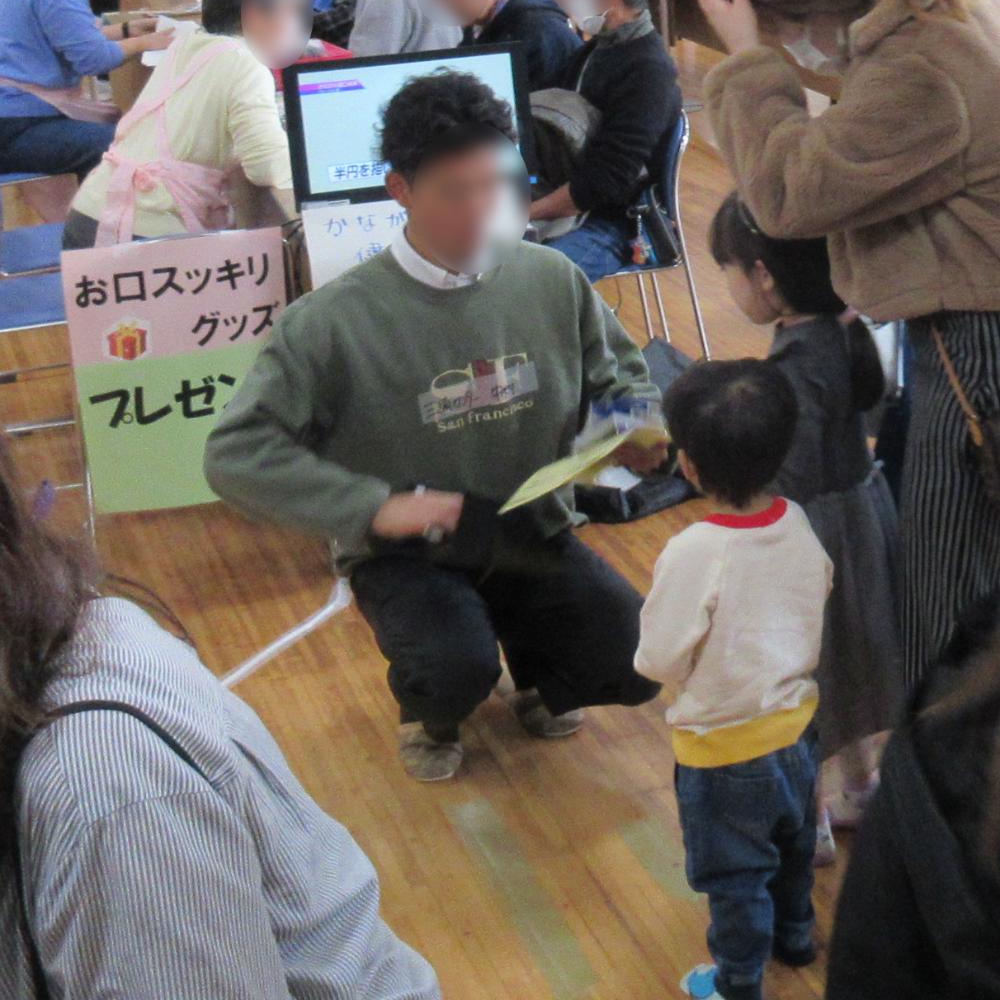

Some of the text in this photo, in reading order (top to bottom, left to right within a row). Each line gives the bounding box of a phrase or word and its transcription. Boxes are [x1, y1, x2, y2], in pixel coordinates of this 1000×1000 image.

[74, 252, 270, 309] お口スッキリ
[192, 302, 280, 347] グッズ
